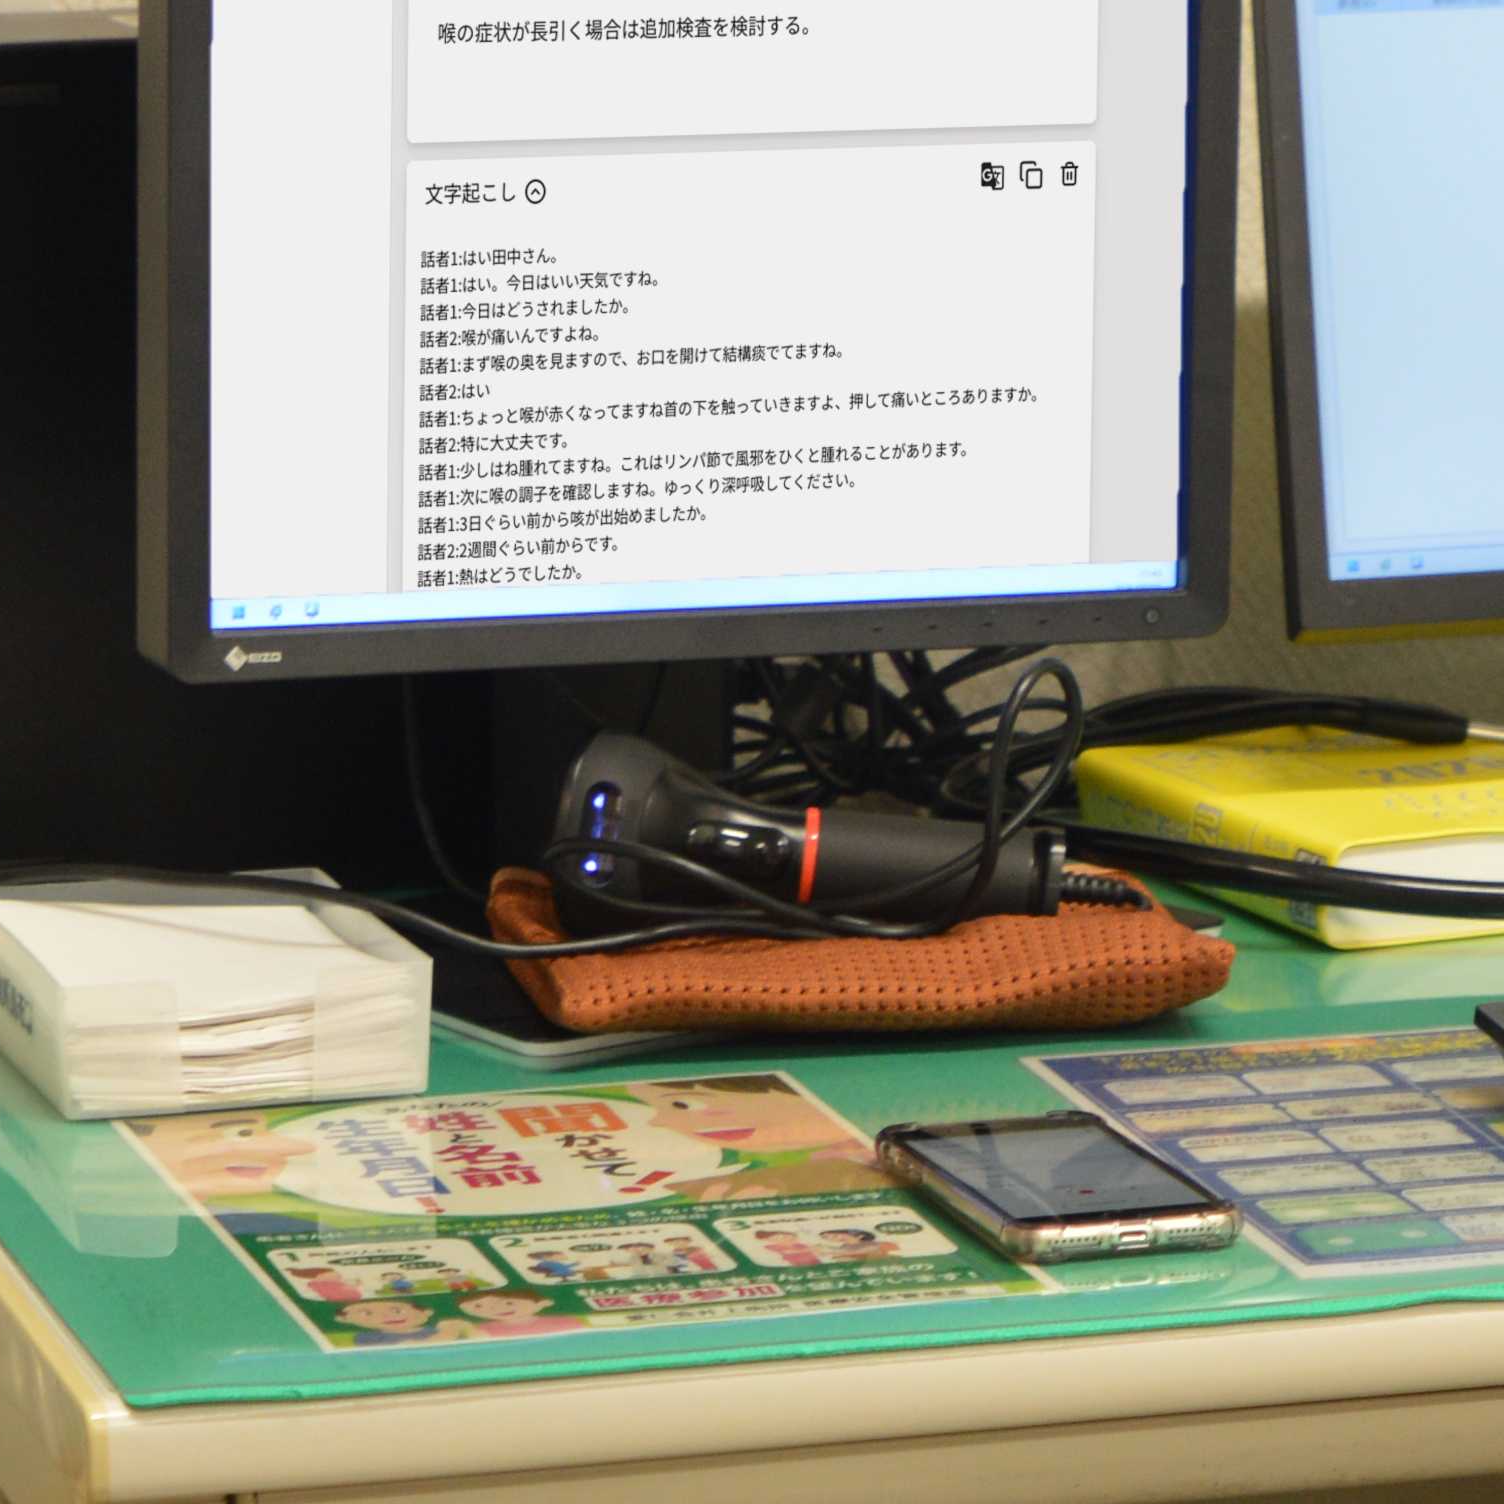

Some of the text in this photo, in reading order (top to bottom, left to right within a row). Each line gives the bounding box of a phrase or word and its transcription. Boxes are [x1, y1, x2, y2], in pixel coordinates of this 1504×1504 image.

[439, 16, 808, 44] 喉の症状が長引く場合は追加検査を検討する。
[426, 183, 515, 204] 文字起こし
[421, 248, 556, 268] 話者1:はい田中さん。
[421, 271, 657, 295] 話者1:はい。今日はいい天気ですね。
[421, 299, 628, 321] 話者1:今日はどうされましたか。
[420, 326, 598, 348] 話者2:喉が痛いんですよね。
[420, 384, 490, 401] 話者2:はい
[419, 433, 566, 454] 話者2:特に大丈夫です。
[418, 506, 705, 534] 話者1:3日ぐらい前から咳が出始めましたか。
[418, 536, 617, 560] 話者2:2週間ぐらい前からです。
[418, 564, 581, 587] 話者1:熱はどうでしたか。
